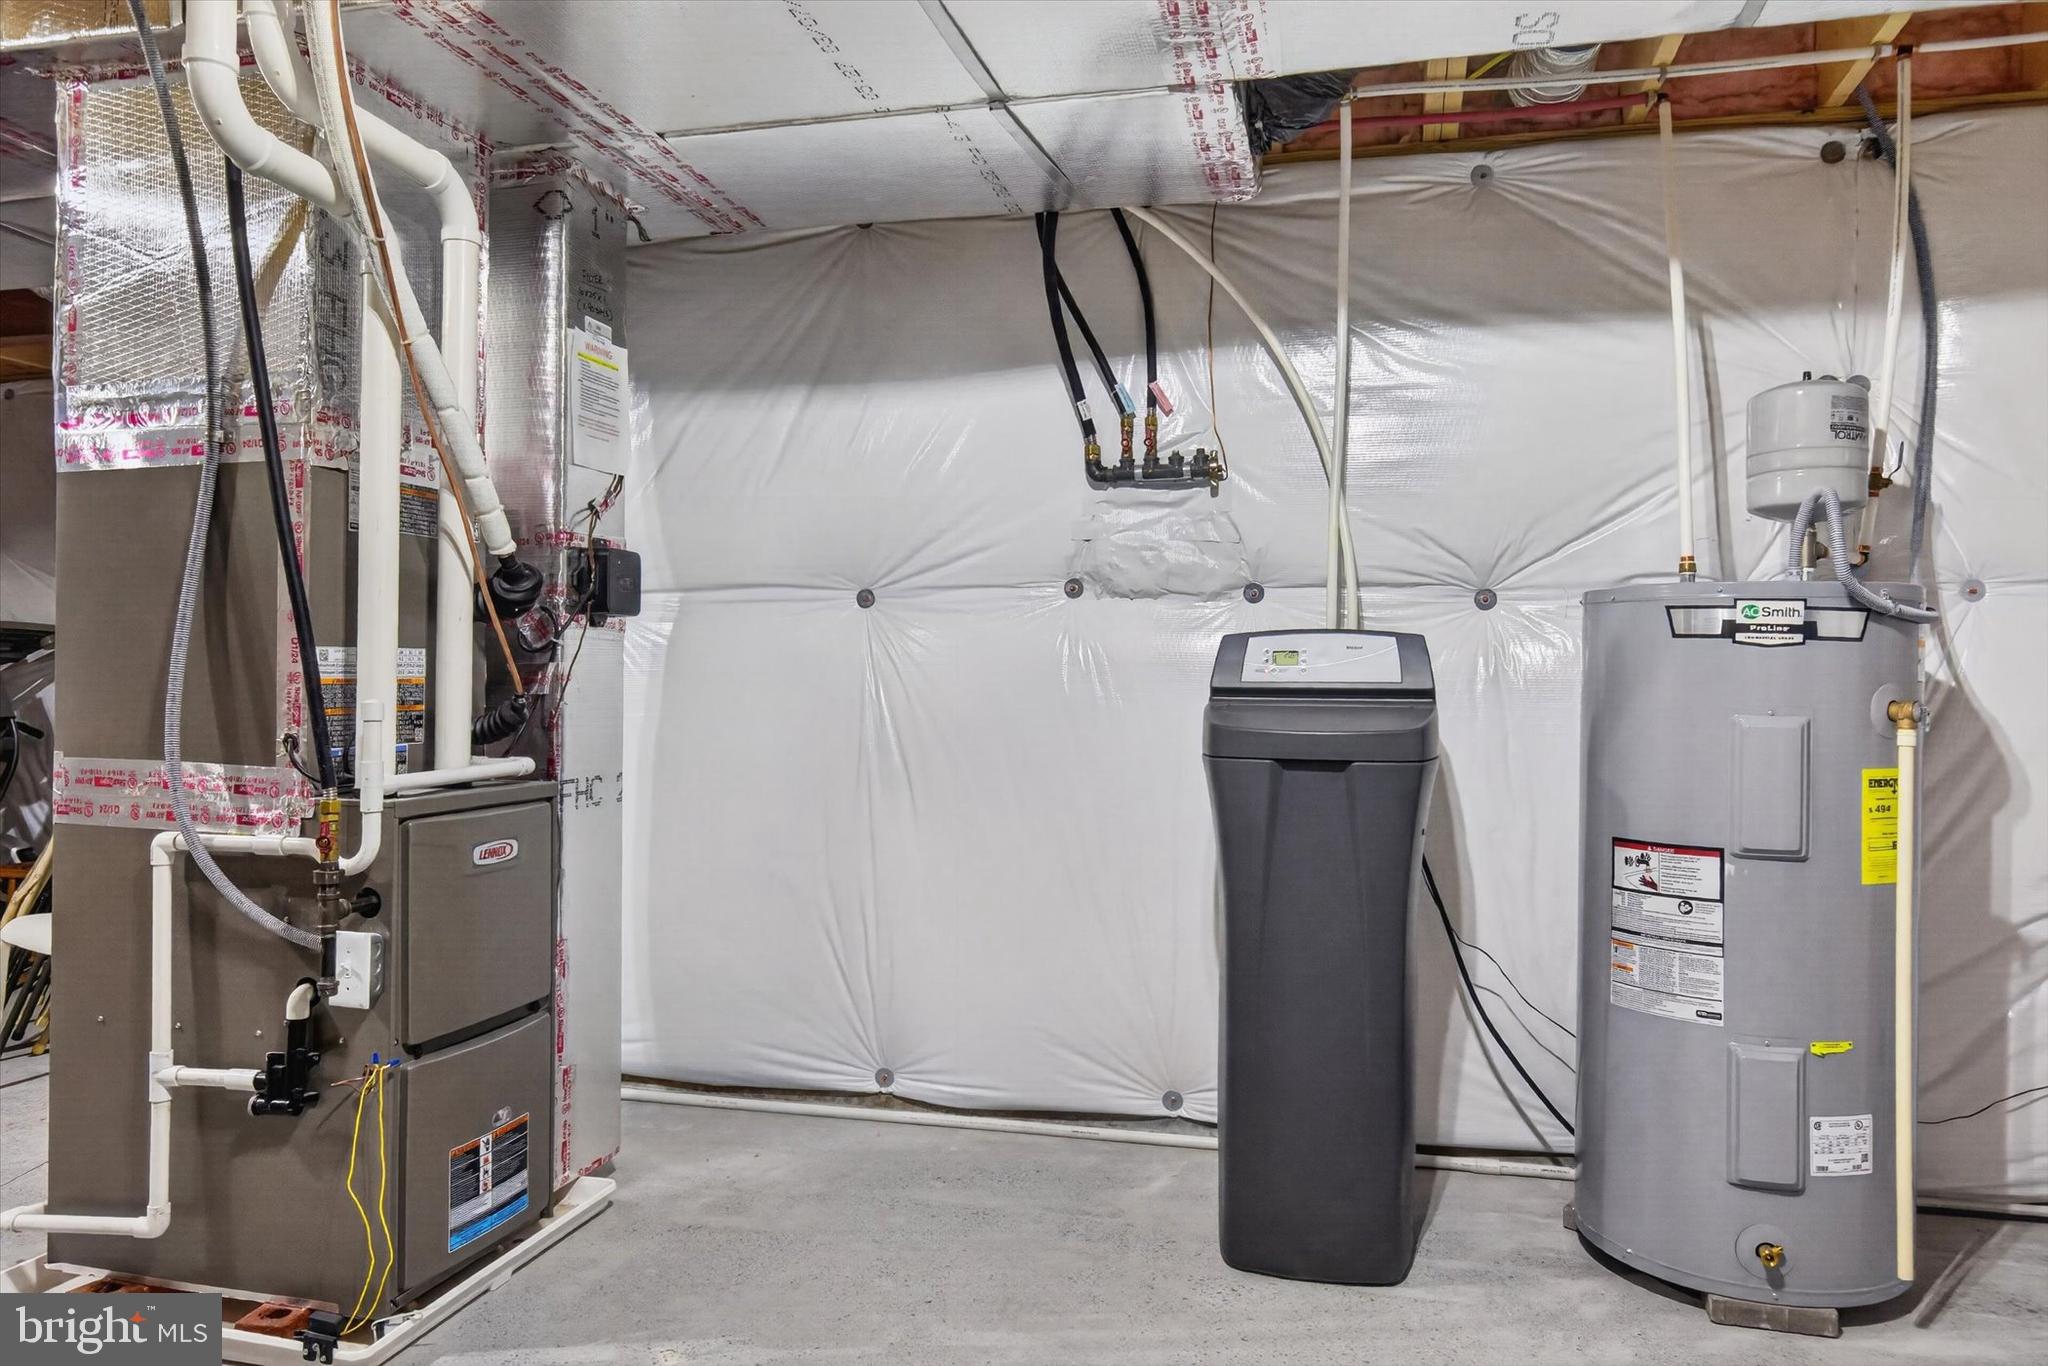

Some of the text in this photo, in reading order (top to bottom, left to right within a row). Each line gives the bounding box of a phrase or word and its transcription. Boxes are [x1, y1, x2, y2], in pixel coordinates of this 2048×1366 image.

[1761, 606, 1800, 618] Smith
[1875, 804, 1891, 813] 494
[479, 845, 506, 860] LENNOX
